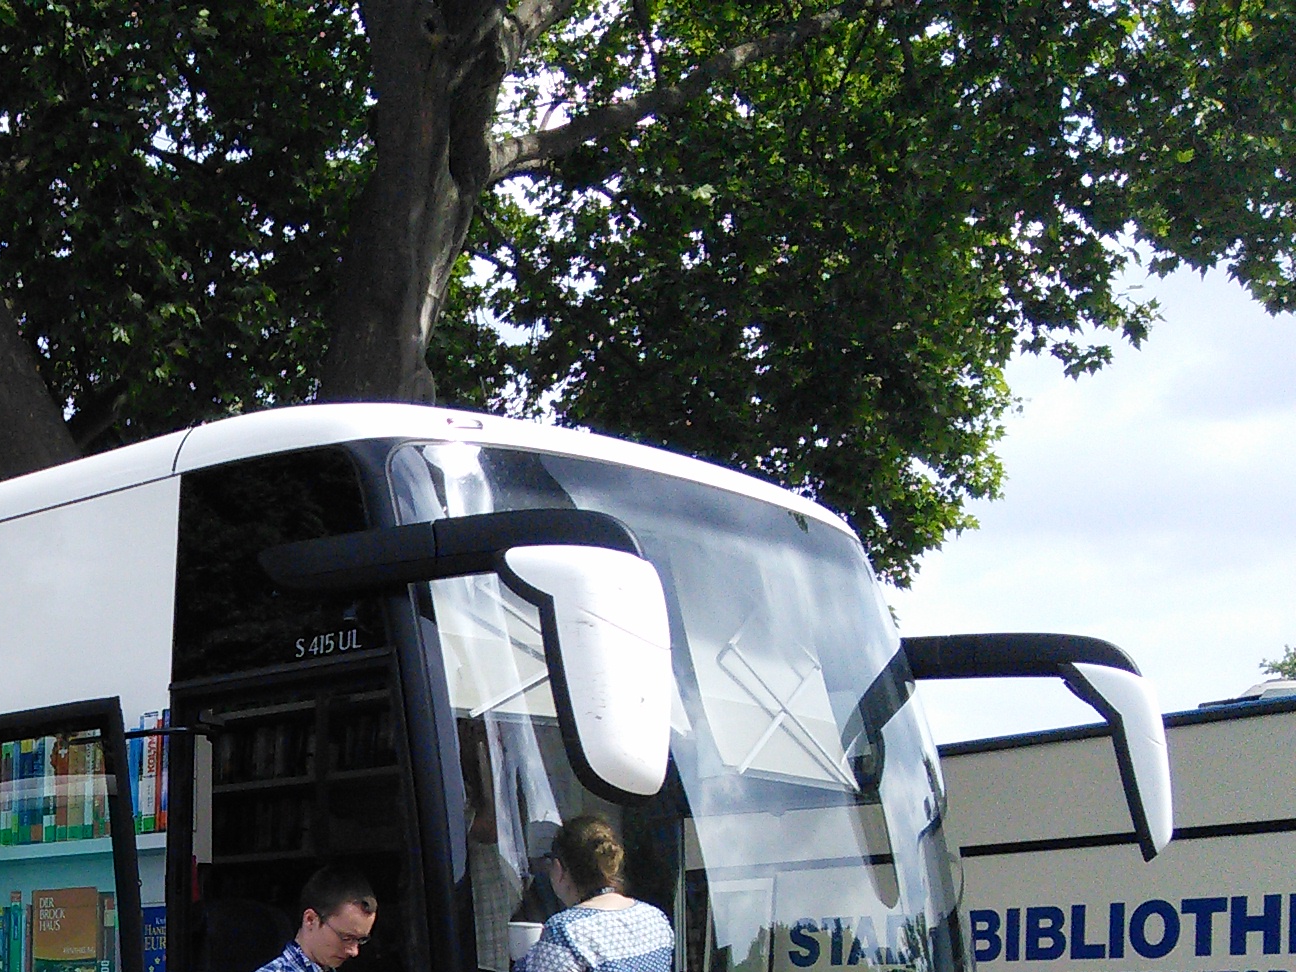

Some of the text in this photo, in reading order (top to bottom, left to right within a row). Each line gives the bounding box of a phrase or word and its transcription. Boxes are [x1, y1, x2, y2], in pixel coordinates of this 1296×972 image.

[295, 628, 362, 658] S 415 UL
[148, 730, 157, 774] KOLYM
[39, 897, 54, 909] DER
[39, 908, 66, 920] BROCK
[39, 919, 61, 932] HAUS
